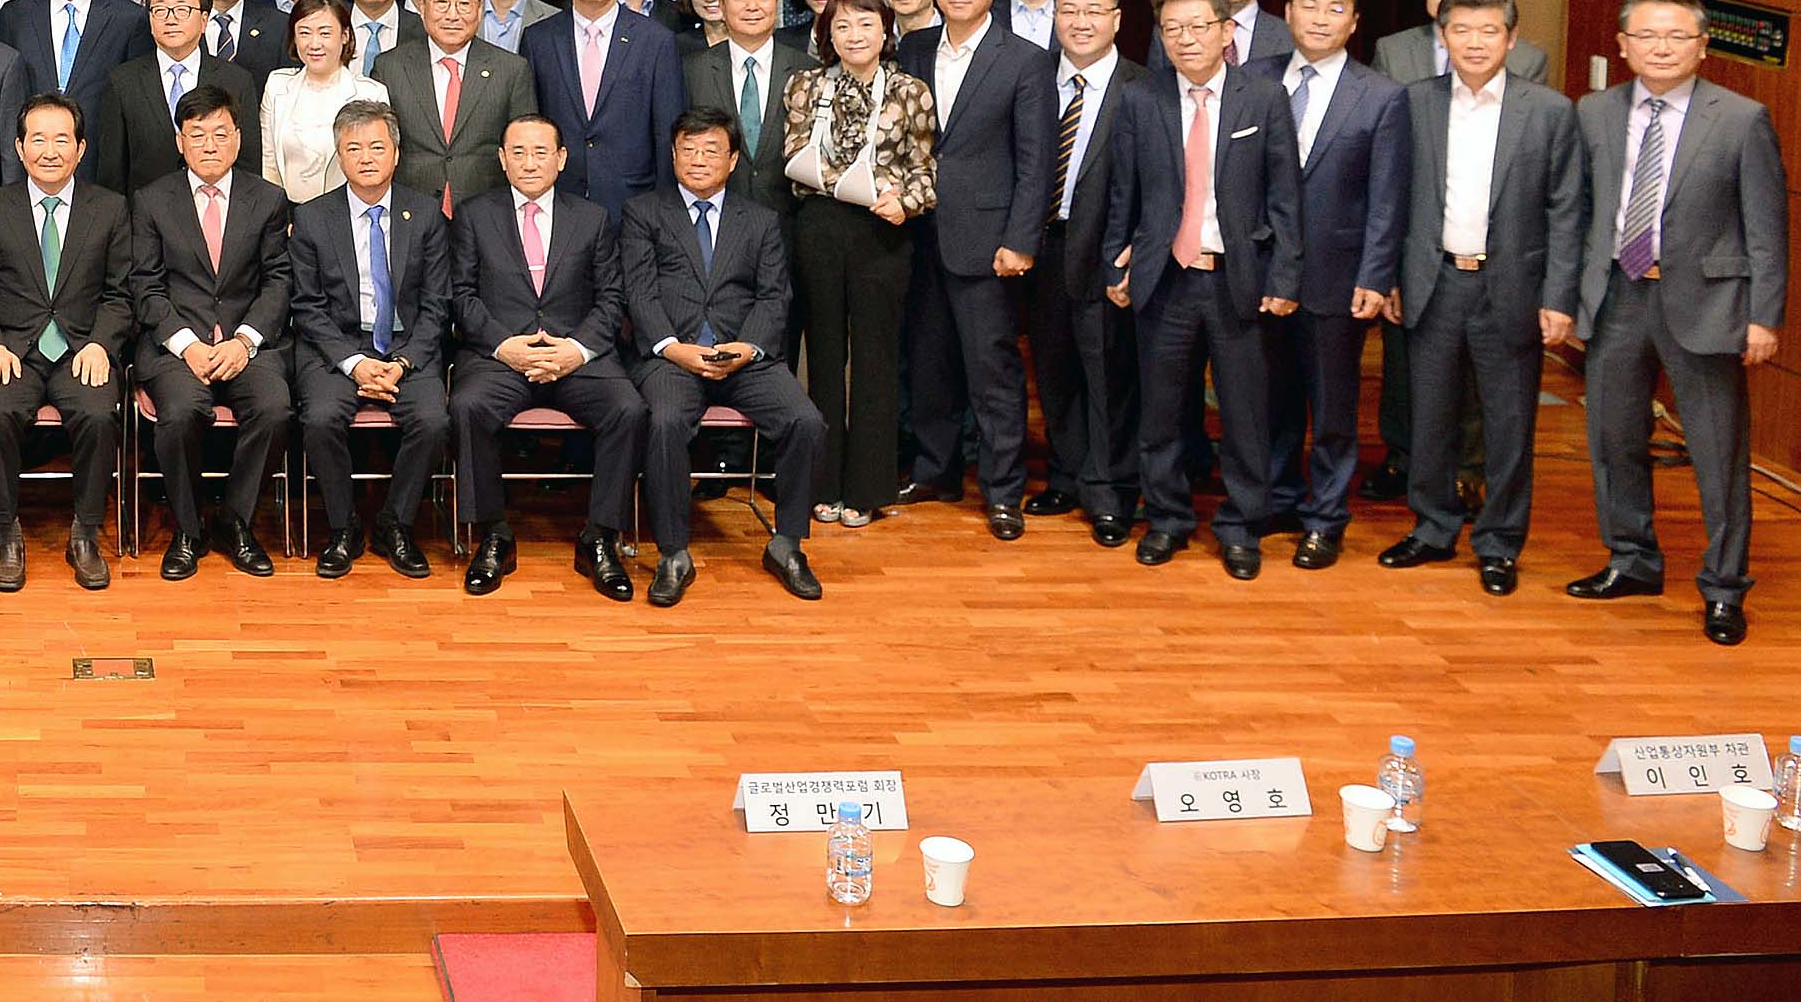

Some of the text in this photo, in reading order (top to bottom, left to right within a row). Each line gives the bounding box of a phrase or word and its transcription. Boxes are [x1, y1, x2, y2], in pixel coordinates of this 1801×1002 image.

[1634, 744, 1720, 760] 산업통상자원부
[748, 779, 897, 795] 글로벌산업경쟁력포럼 회장
